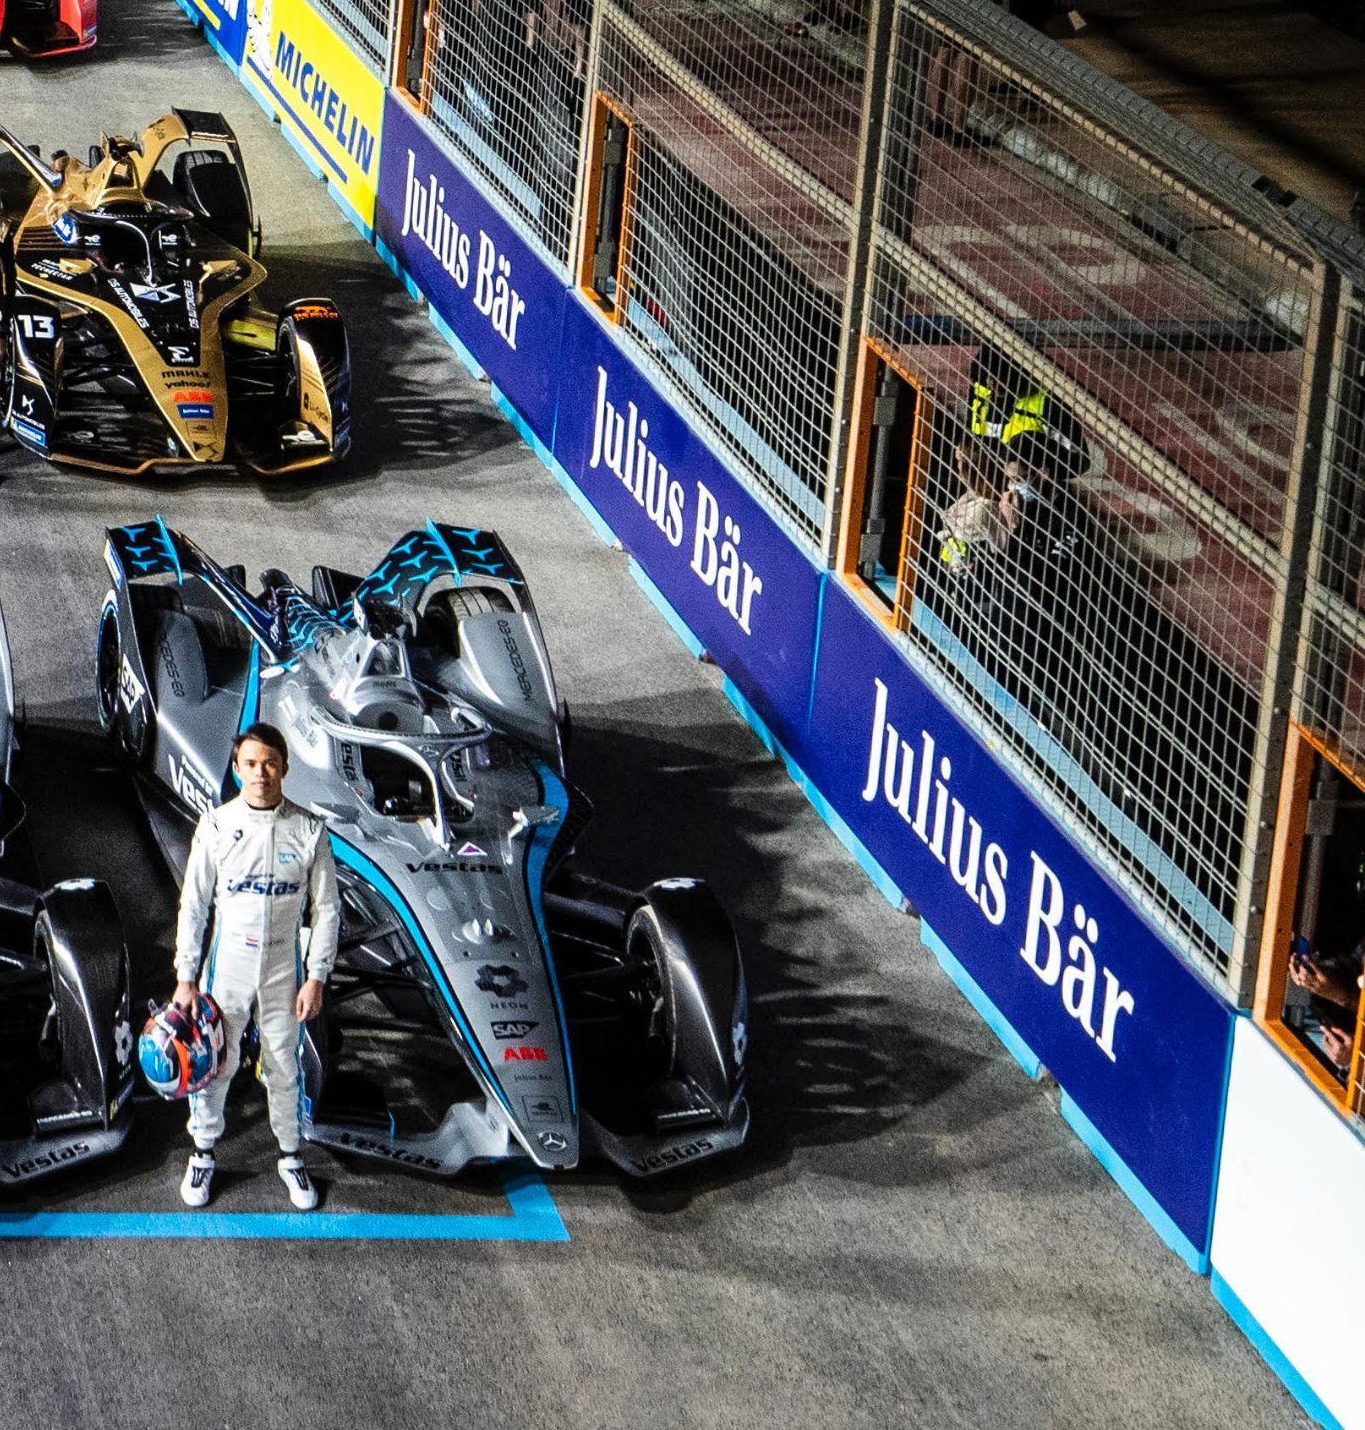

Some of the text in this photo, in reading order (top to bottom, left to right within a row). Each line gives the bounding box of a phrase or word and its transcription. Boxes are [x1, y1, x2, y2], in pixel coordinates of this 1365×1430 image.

[275, 30, 375, 176] MICHELIN
[401, 148, 526, 352] Julius Bär
[17, 313, 55, 340] 13
[162, 370, 211, 379] MAHLE
[173, 391, 214, 403] ABB
[589, 366, 763, 637] Julius Bär
[862, 676, 1135, 1064] Julius Bär
[227, 878, 300, 896] Vestas
[490, 1001, 529, 1010] NEOM
[491, 1022, 530, 1037] SAP
[502, 1046, 549, 1062] ABB
[1, 1139, 91, 1179] Vestas
[635, 1138, 714, 1174] Vestas
